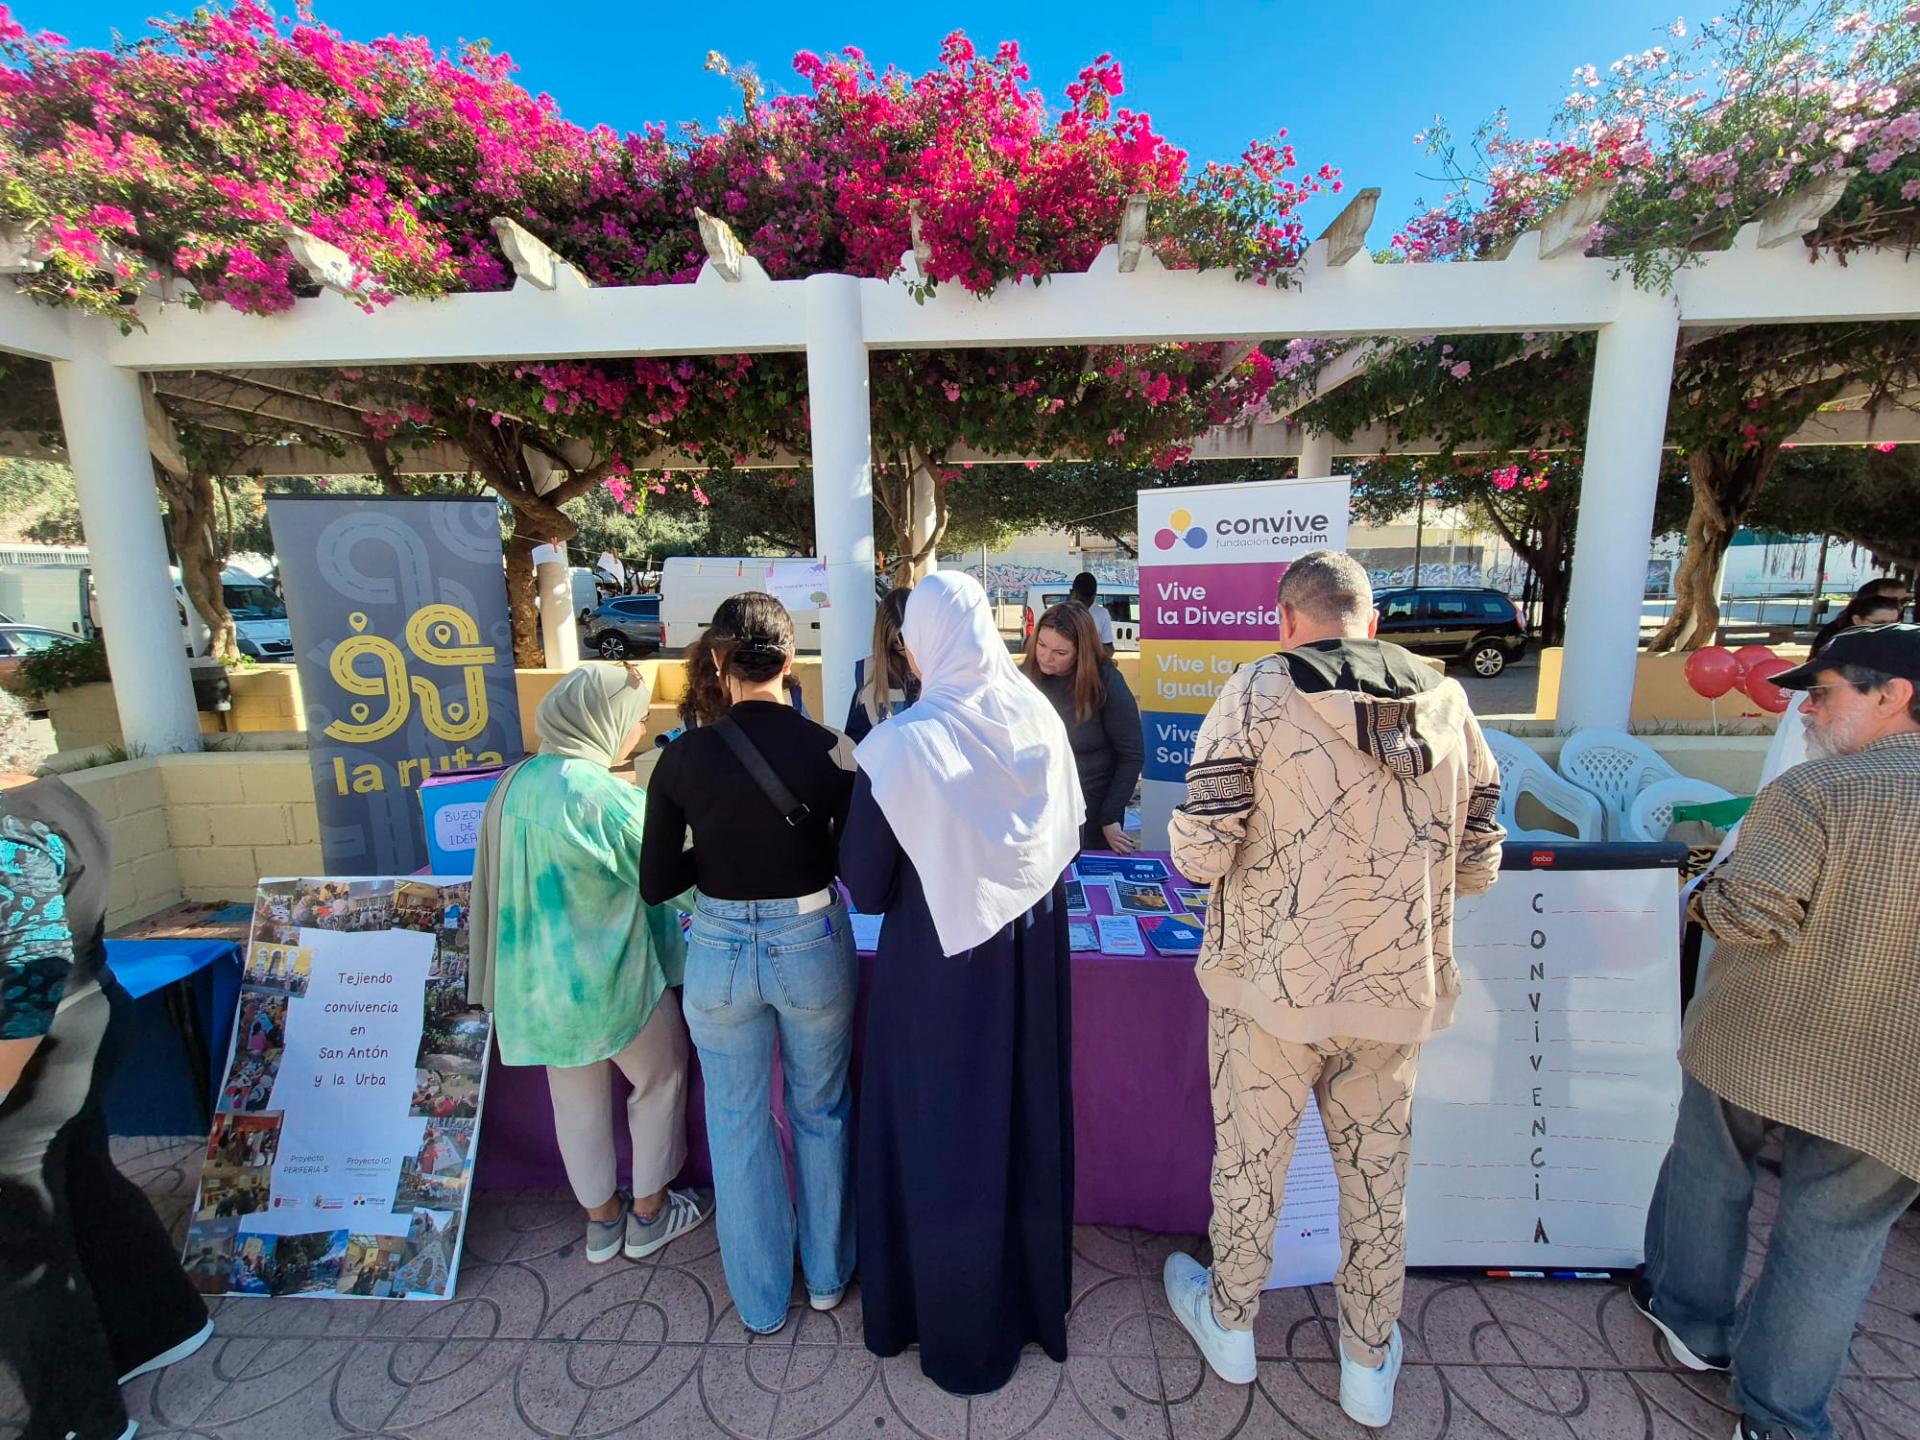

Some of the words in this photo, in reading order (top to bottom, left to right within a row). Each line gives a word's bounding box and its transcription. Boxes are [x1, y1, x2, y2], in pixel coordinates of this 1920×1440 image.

[1216, 509, 1329, 535] convive
[1216, 538, 1269, 549] fundación
[1271, 531, 1328, 547] cepaim
[1157, 581, 1206, 601] Vive
[1157, 606, 1179, 625] la
[1185, 605, 1281, 625] Diversid
[1156, 653, 1205, 673] Vive
[1211, 655, 1233, 674] la
[1156, 723, 1199, 743] Vive
[1156, 746, 1195, 765] Soli
[333, 757, 385, 796] la
[460, 821, 475, 832] DE
[449, 832, 478, 846] IDEA
[338, 972, 393, 986] Tejiendo
[324, 1000, 399, 1013] convivencia
[350, 1026, 366, 1036] en
[319, 1047, 344, 1059] San
[347, 1045, 389, 1059] Antón
[314, 1075, 323, 1088] y
[333, 1073, 345, 1085] la
[355, 1073, 386, 1085] Urba
[290, 1155, 325, 1163] Proyecto
[346, 1157, 379, 1166] Proyecto
